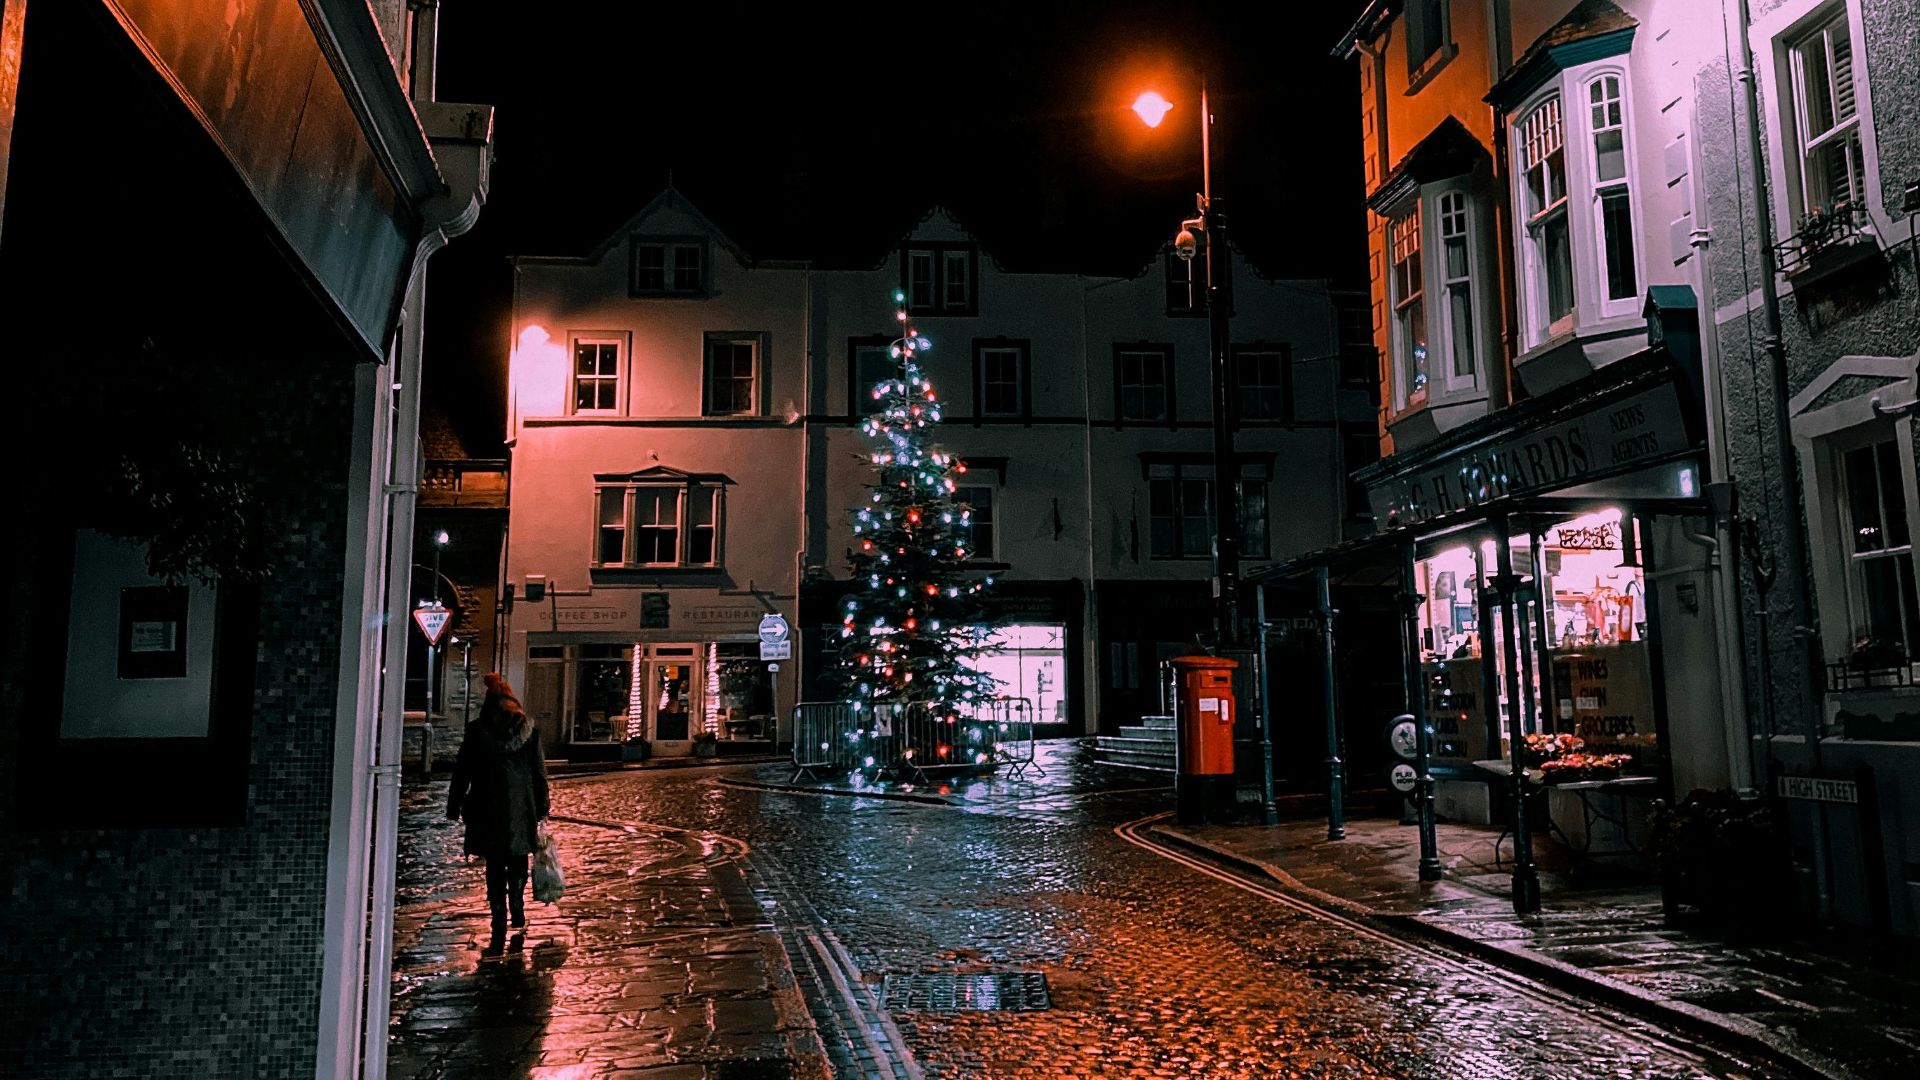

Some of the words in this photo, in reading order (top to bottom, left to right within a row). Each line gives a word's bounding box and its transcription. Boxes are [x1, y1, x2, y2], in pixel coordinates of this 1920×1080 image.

[1609, 404, 1646, 433] NEWS
[1611, 431, 1659, 464] AGENTS
[1460, 427, 1589, 505] EDWARDS
[539, 611, 586, 620] COFFEE
[593, 611, 628, 620] SHOP
[1577, 658, 1608, 680] WINES
[1581, 715, 1636, 737] GROCERIES
[1789, 779, 1813, 798] HIGH
[1816, 781, 1855, 801] STREET
